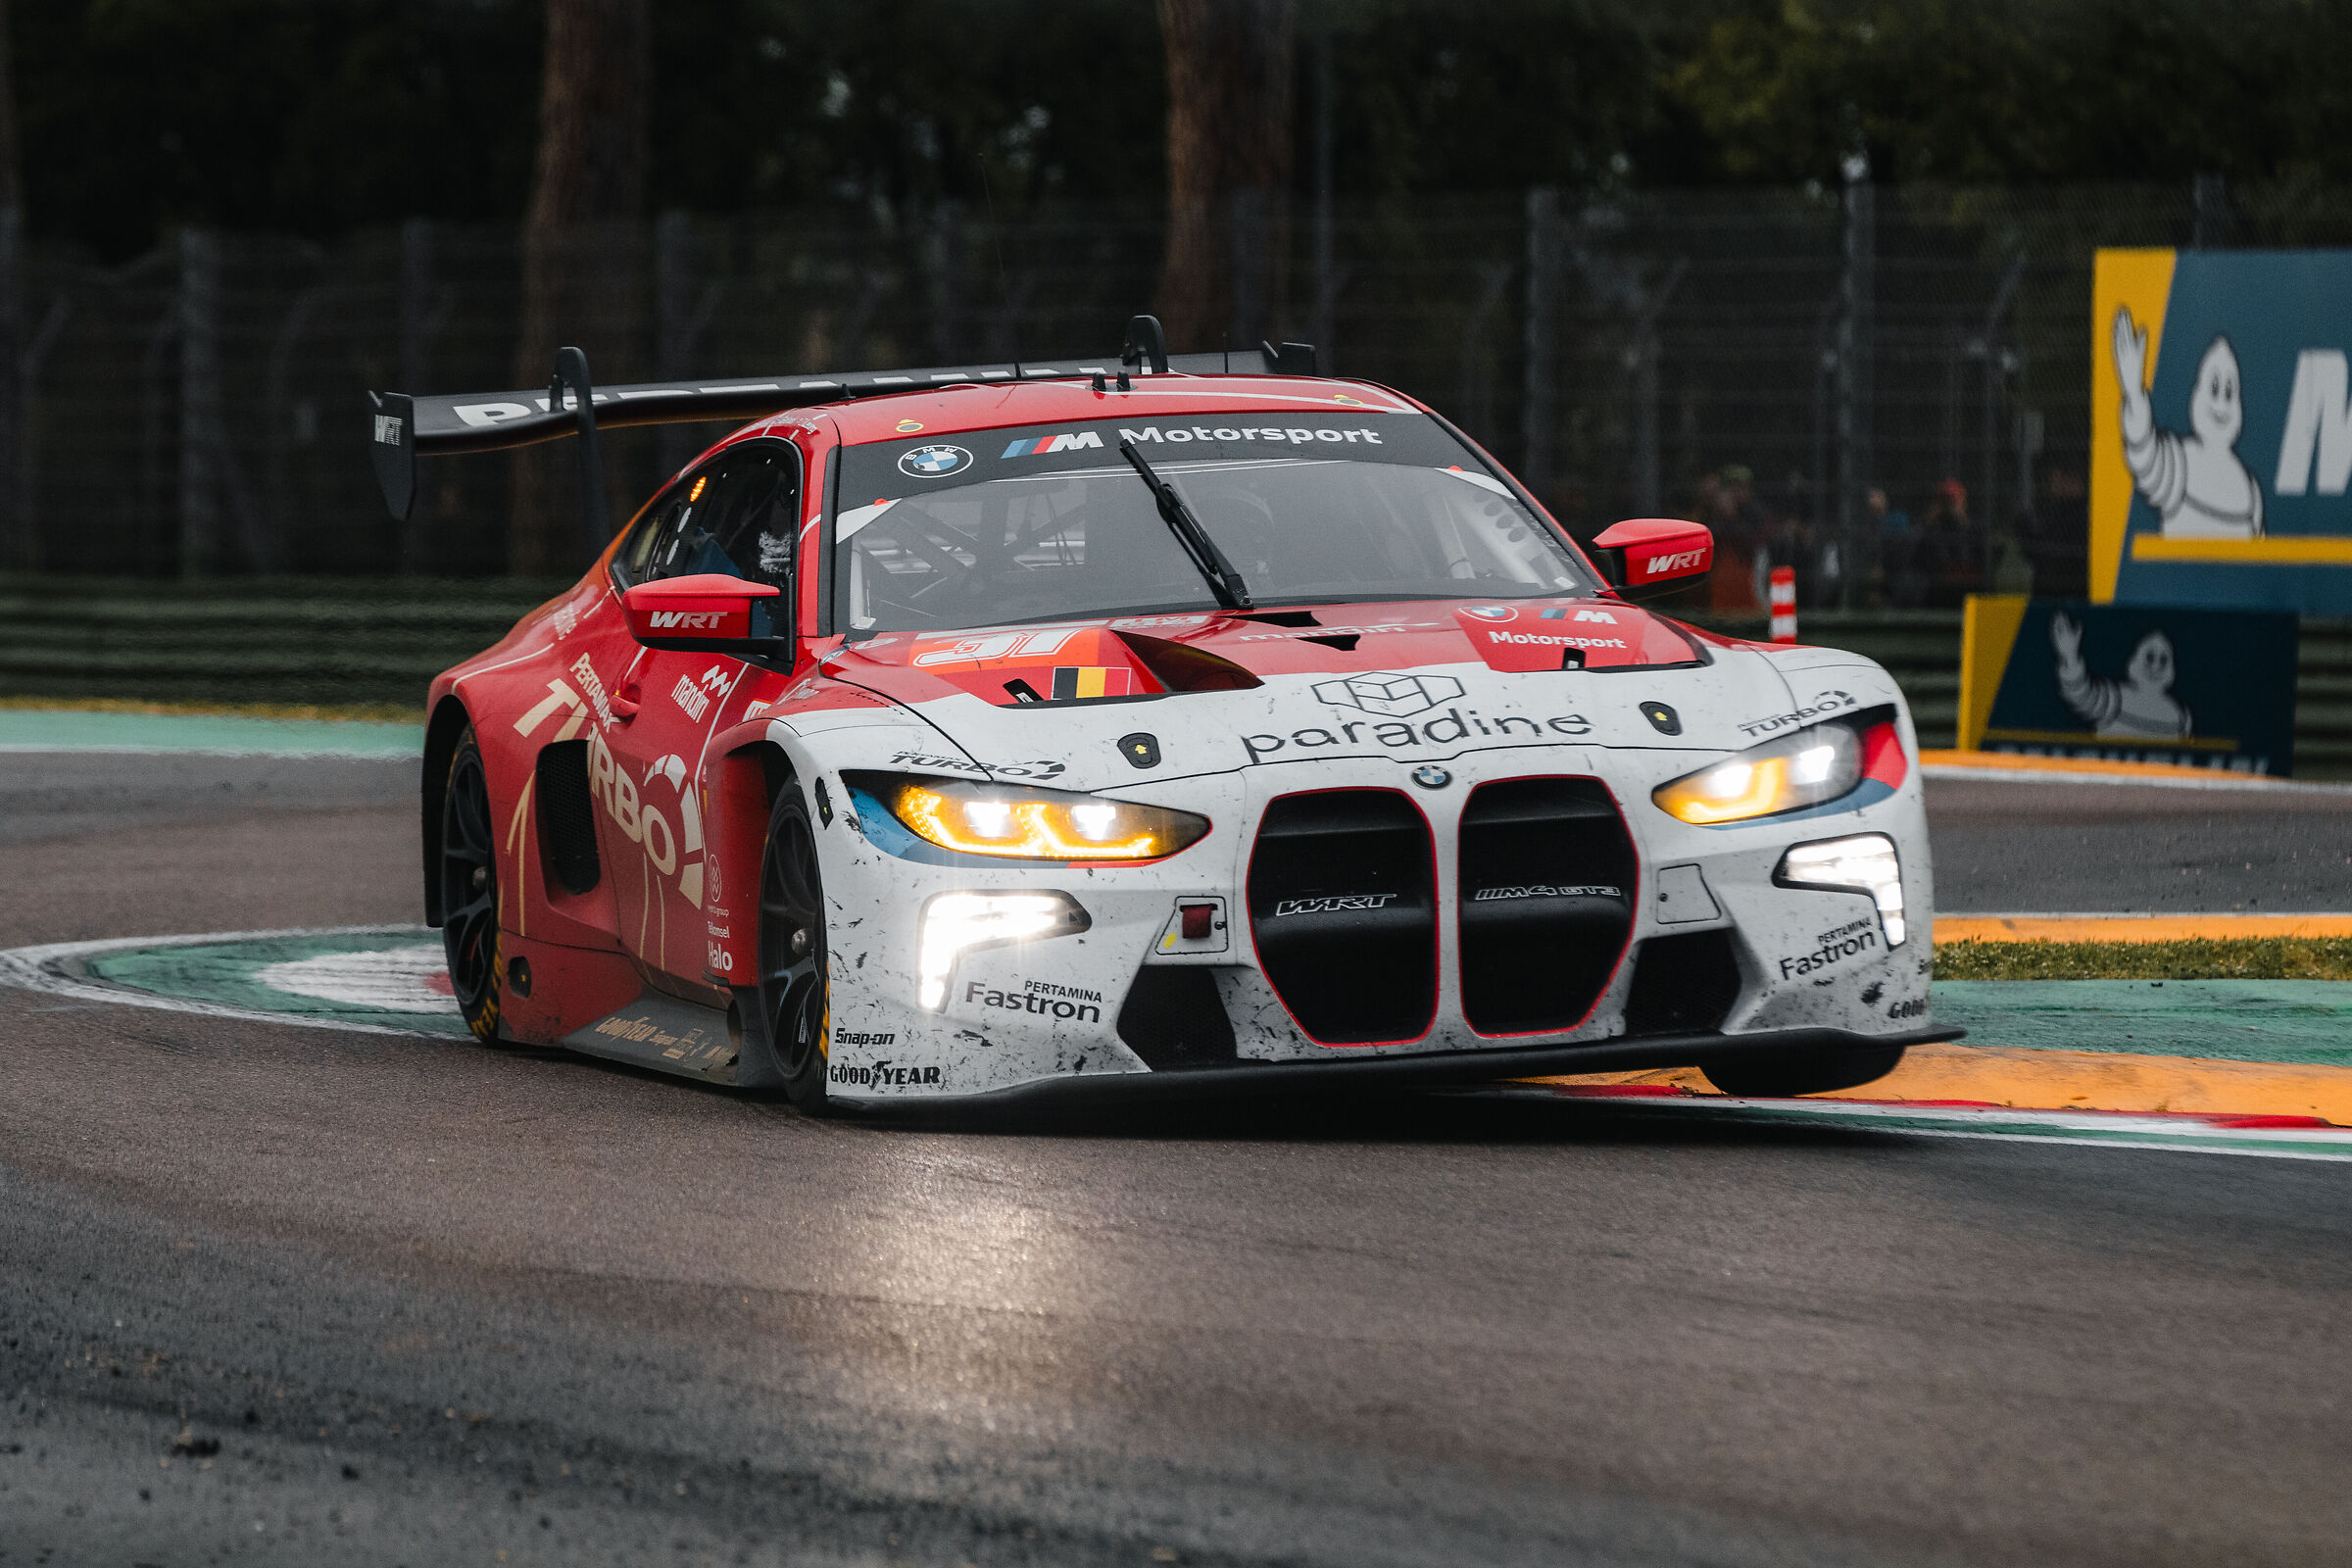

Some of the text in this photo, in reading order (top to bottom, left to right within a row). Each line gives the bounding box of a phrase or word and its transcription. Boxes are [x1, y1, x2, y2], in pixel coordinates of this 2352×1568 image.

[1118, 426, 1383, 445] Motorsport
[1646, 547, 1707, 574] WRT
[650, 611, 728, 629] WRT
[1488, 630, 1628, 649] Motorsport
[1741, 700, 1839, 737] TURBO
[1241, 708, 1593, 765] paradine
[889, 754, 1033, 776] TURBO
[1276, 893, 1397, 916] WRT
[1817, 916, 1874, 945] PERTAMINA
[708, 940, 733, 971] Halo
[1780, 931, 1876, 981] Fastron
[965, 981, 1102, 1024] Fastron
[1024, 980, 1102, 1004] PERTAMINA
[834, 1027, 896, 1048] Snap-on
[829, 1061, 941, 1091] GOODYEAR
